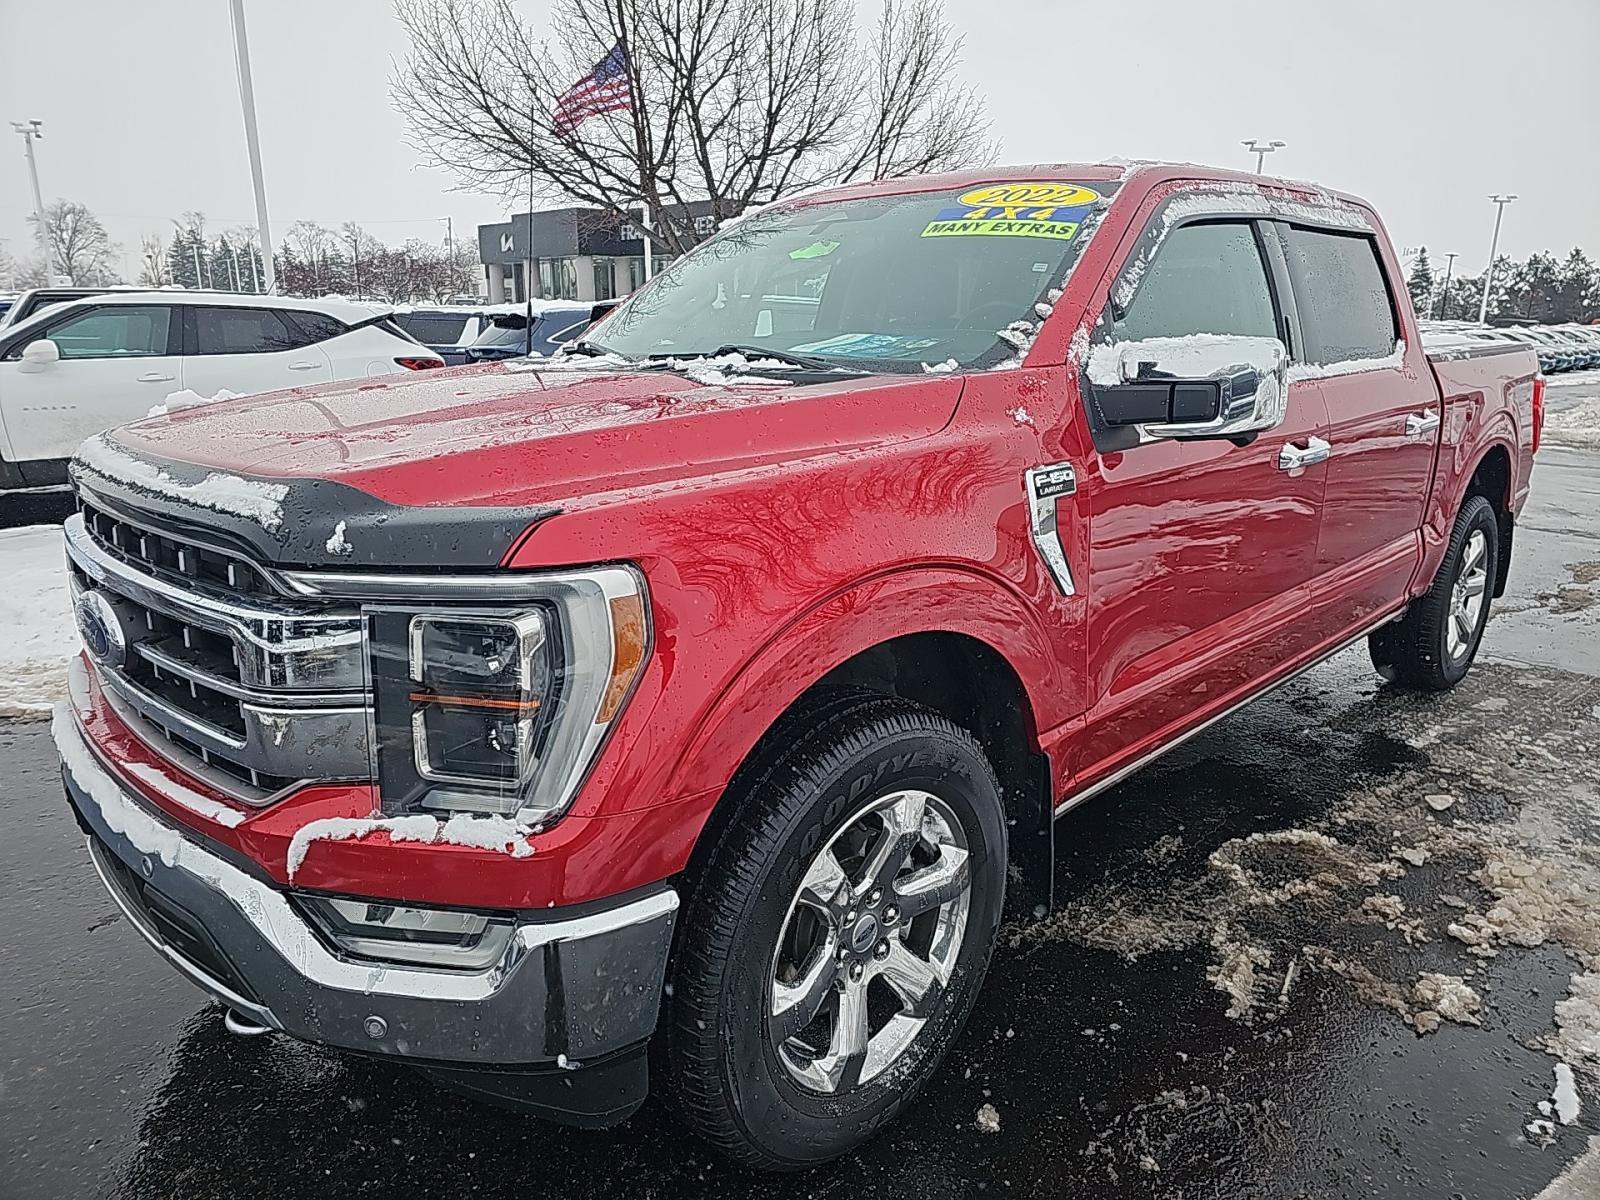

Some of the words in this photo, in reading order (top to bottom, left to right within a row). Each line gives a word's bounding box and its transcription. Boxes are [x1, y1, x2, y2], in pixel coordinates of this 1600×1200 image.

[981, 188, 1077, 203] 2022
[926, 222, 985, 234] MANY
[988, 222, 1073, 235] EXTRAS
[1034, 469, 1074, 488] F-150
[1039, 484, 1064, 496] LARIAT
